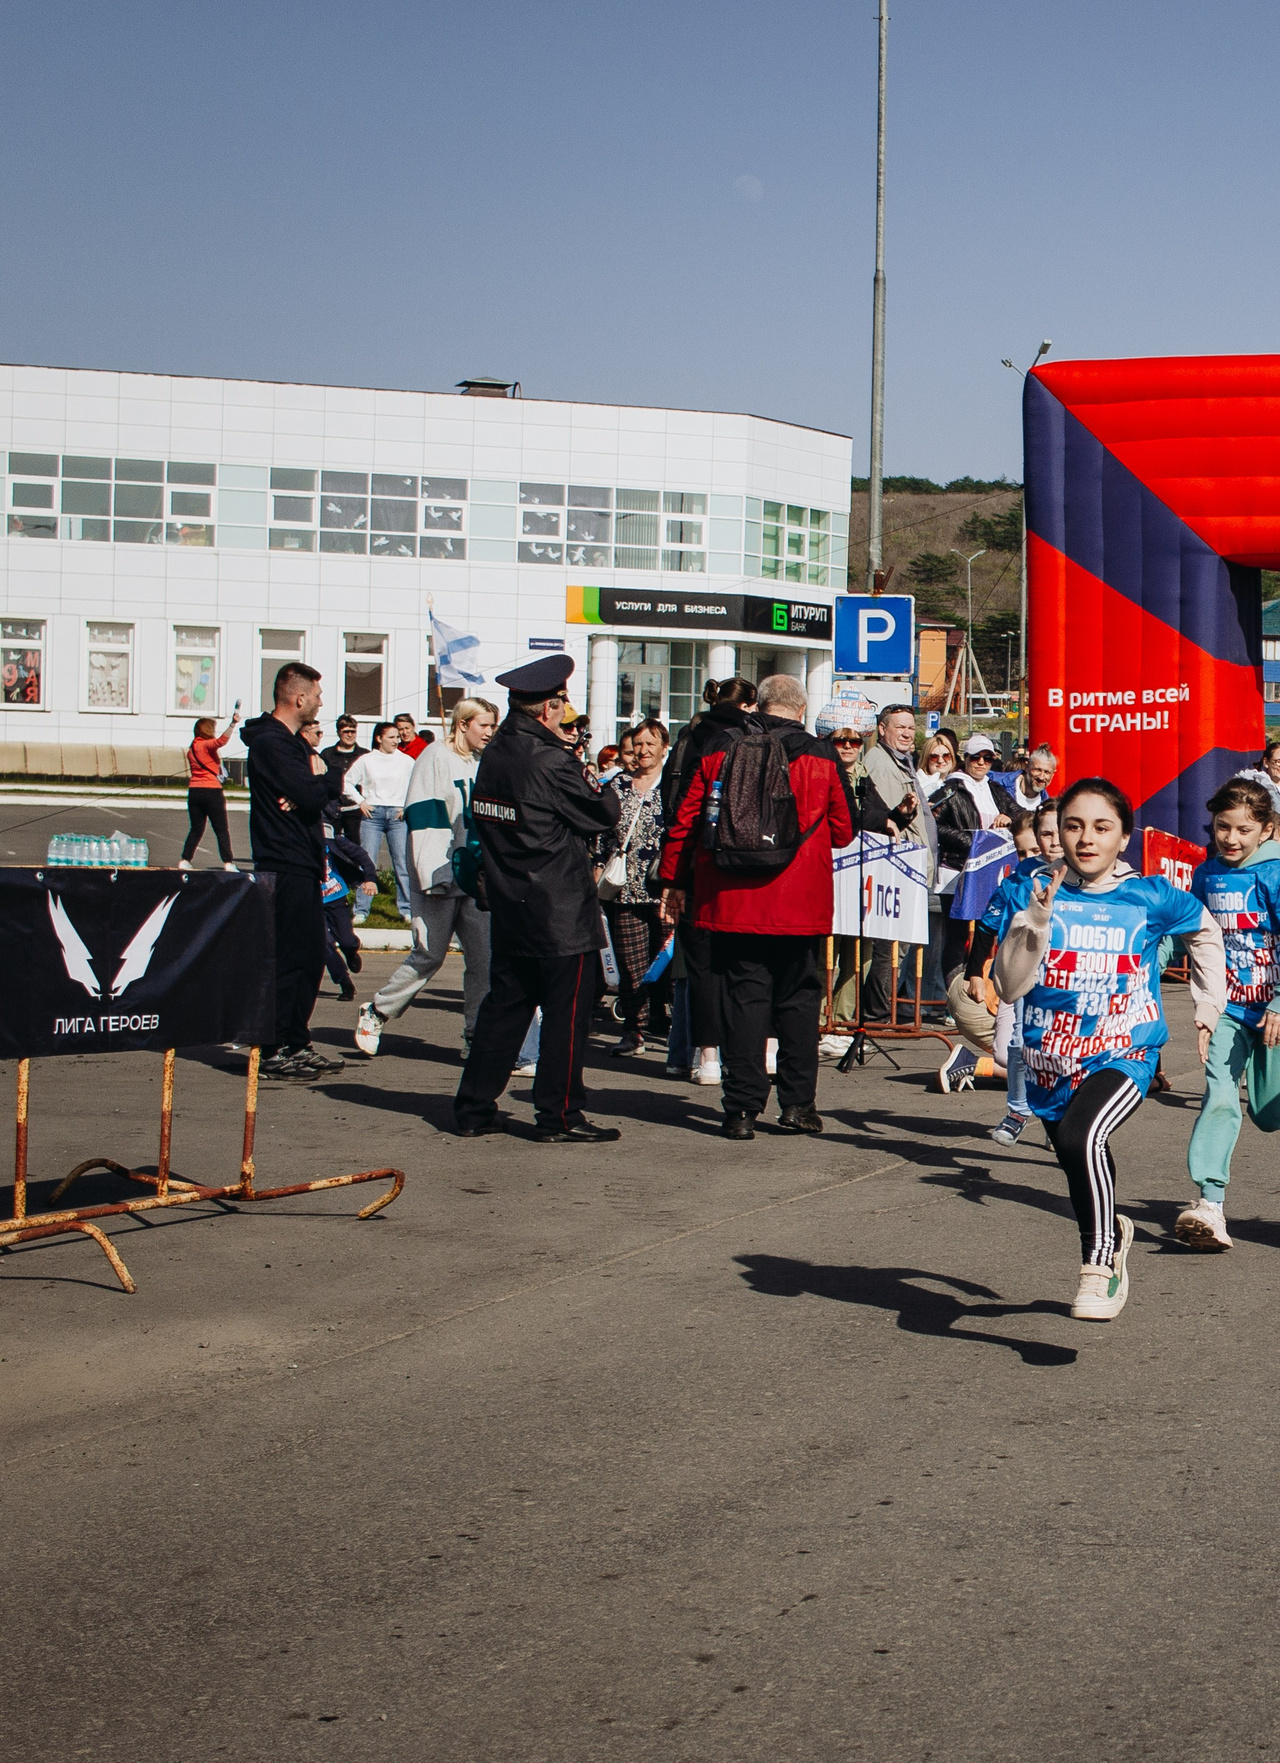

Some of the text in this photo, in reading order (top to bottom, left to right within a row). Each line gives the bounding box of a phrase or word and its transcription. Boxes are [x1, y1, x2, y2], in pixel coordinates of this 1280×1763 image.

[615, 601, 727, 615] УСЛУГИ ДЛЯ БИЗНЕСА
[791, 604, 828, 622] ИТУРУП
[791, 621, 807, 632] БАНК
[858, 608, 896, 663] P
[3, 664, 18, 687] 9
[25, 651, 39, 704] МАЯ
[1048, 683, 1190, 710] В ритме всей
[929, 713, 938, 728] P
[1069, 710, 1170, 733] СТРАНЫ!
[473, 800, 516, 822] ПОЛИЦИЯ
[876, 884, 901, 919] ПСБ
[1207, 892, 1244, 912] 00506
[1069, 924, 1126, 951] 00510
[53, 1013, 160, 1035] ЛИГА ГЕРОЕВ
